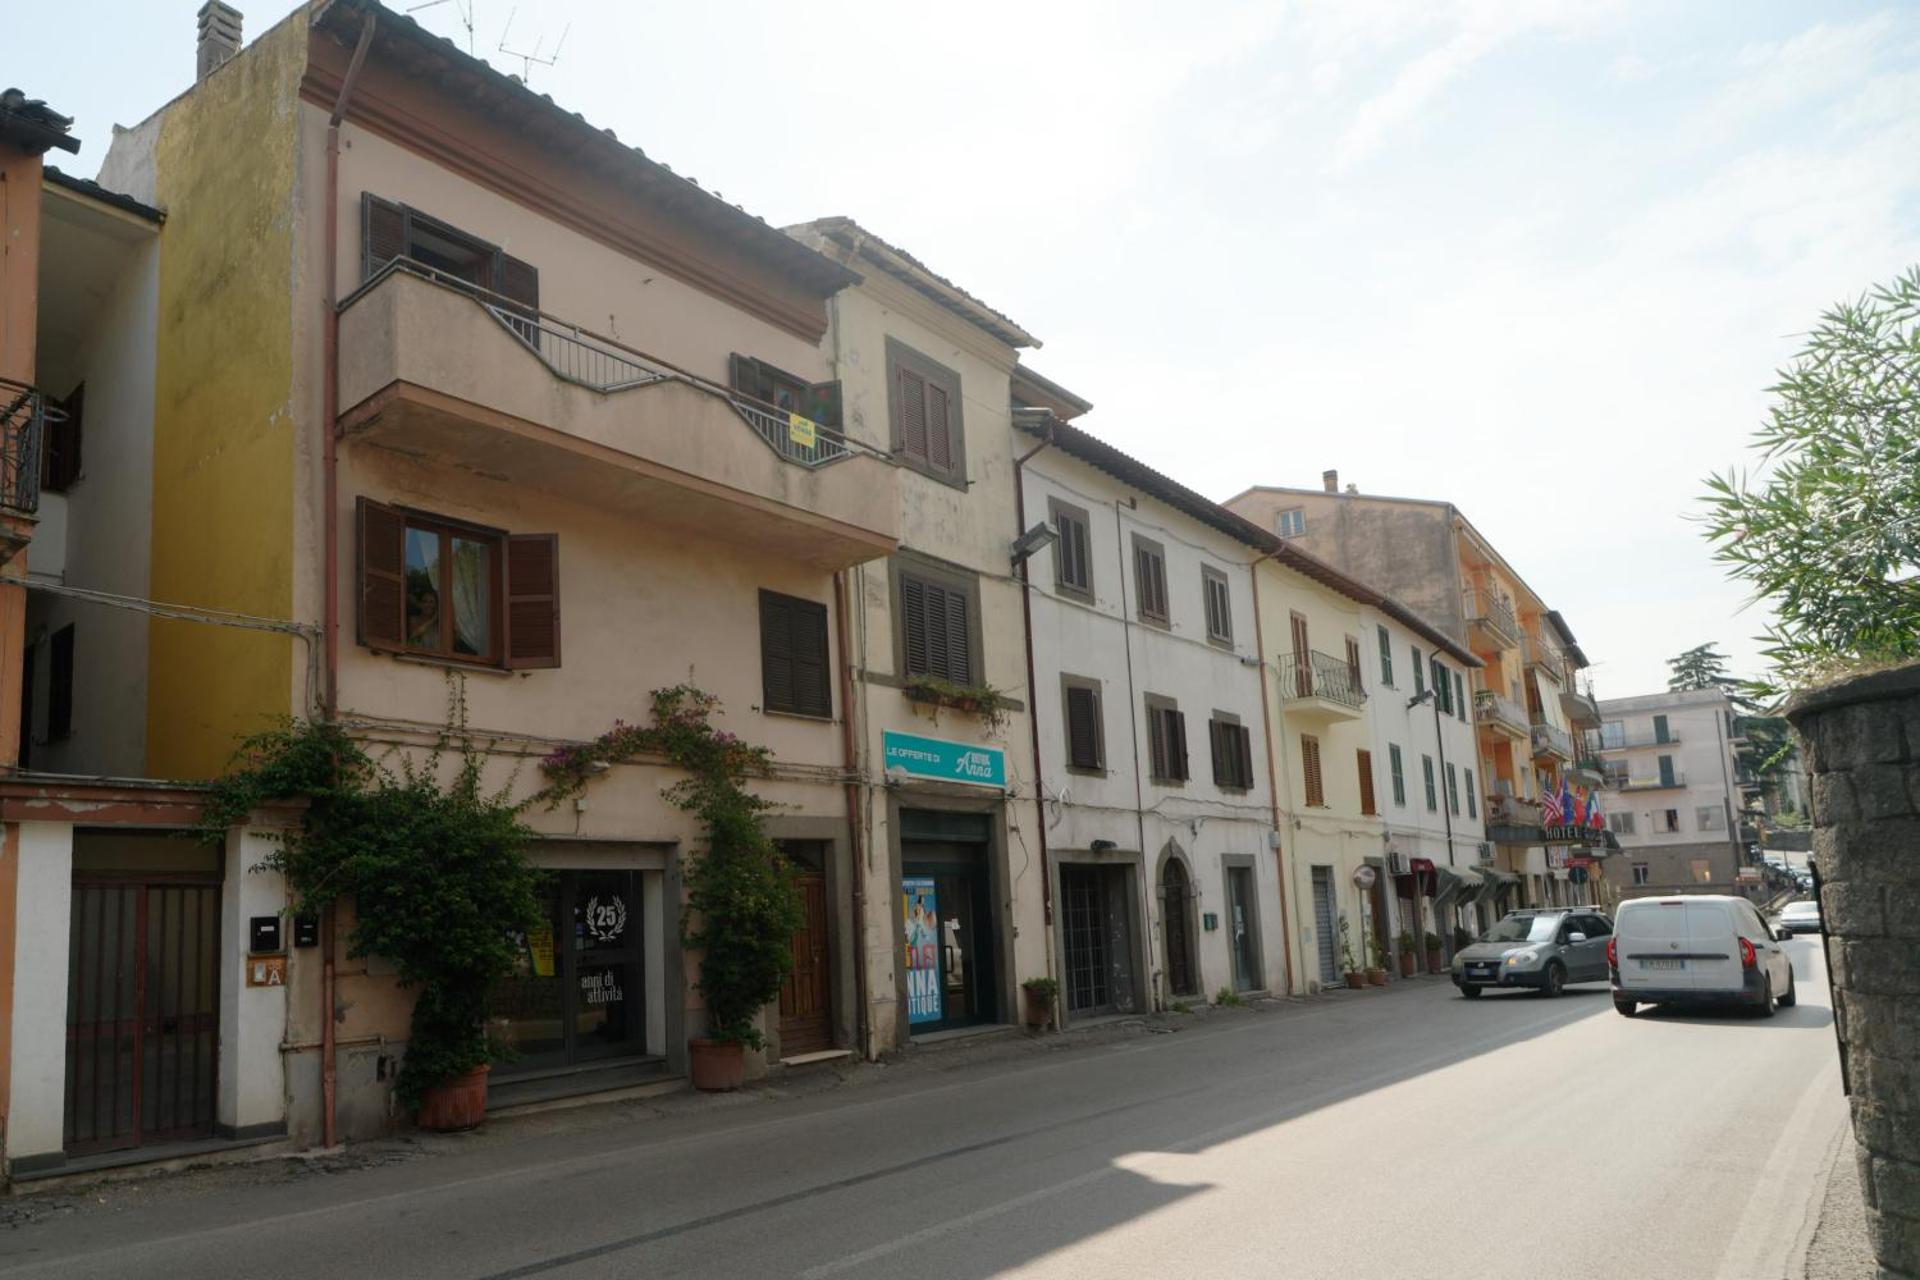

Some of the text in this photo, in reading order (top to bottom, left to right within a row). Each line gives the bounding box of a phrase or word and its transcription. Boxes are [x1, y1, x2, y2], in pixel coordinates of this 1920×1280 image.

[886, 746, 898, 756] LE
[898, 748, 932, 762] OFFERTE
[955, 751, 993, 778] Anna
[1546, 827, 1580, 840] HOTEL
[597, 905, 616, 926] 25
[581, 970, 614, 988] anni di
[588, 985, 623, 1003] attività
